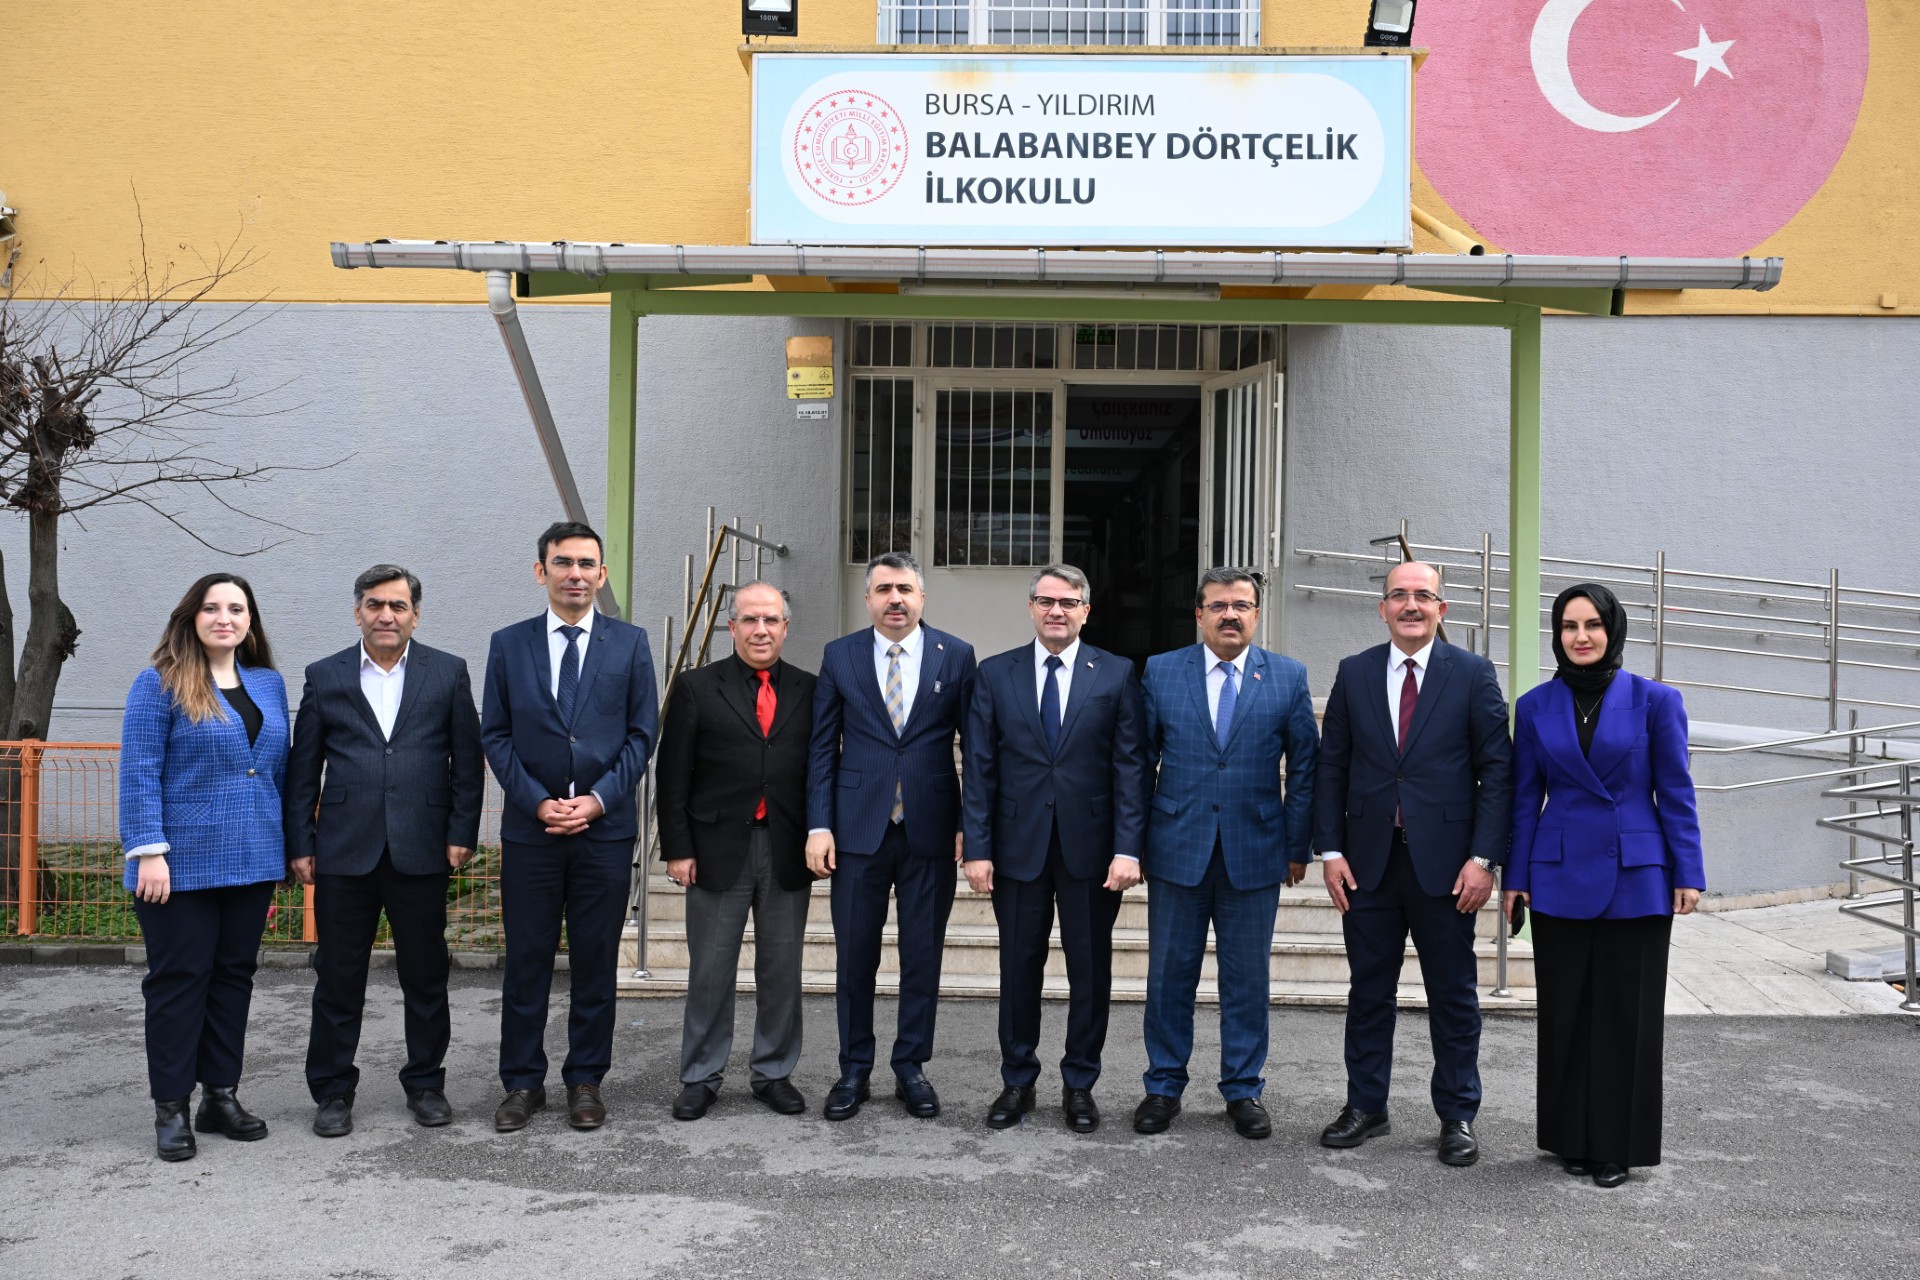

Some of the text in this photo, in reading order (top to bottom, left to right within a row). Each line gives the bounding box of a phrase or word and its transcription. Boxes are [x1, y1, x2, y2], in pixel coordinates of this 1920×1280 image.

[925, 93, 1014, 116] BURSA
[1037, 93, 1155, 116] YILDIRIM
[926, 126, 1359, 168] BALABANBEY DÖRTÇELİK
[925, 170, 1096, 205] İLKOKULU
